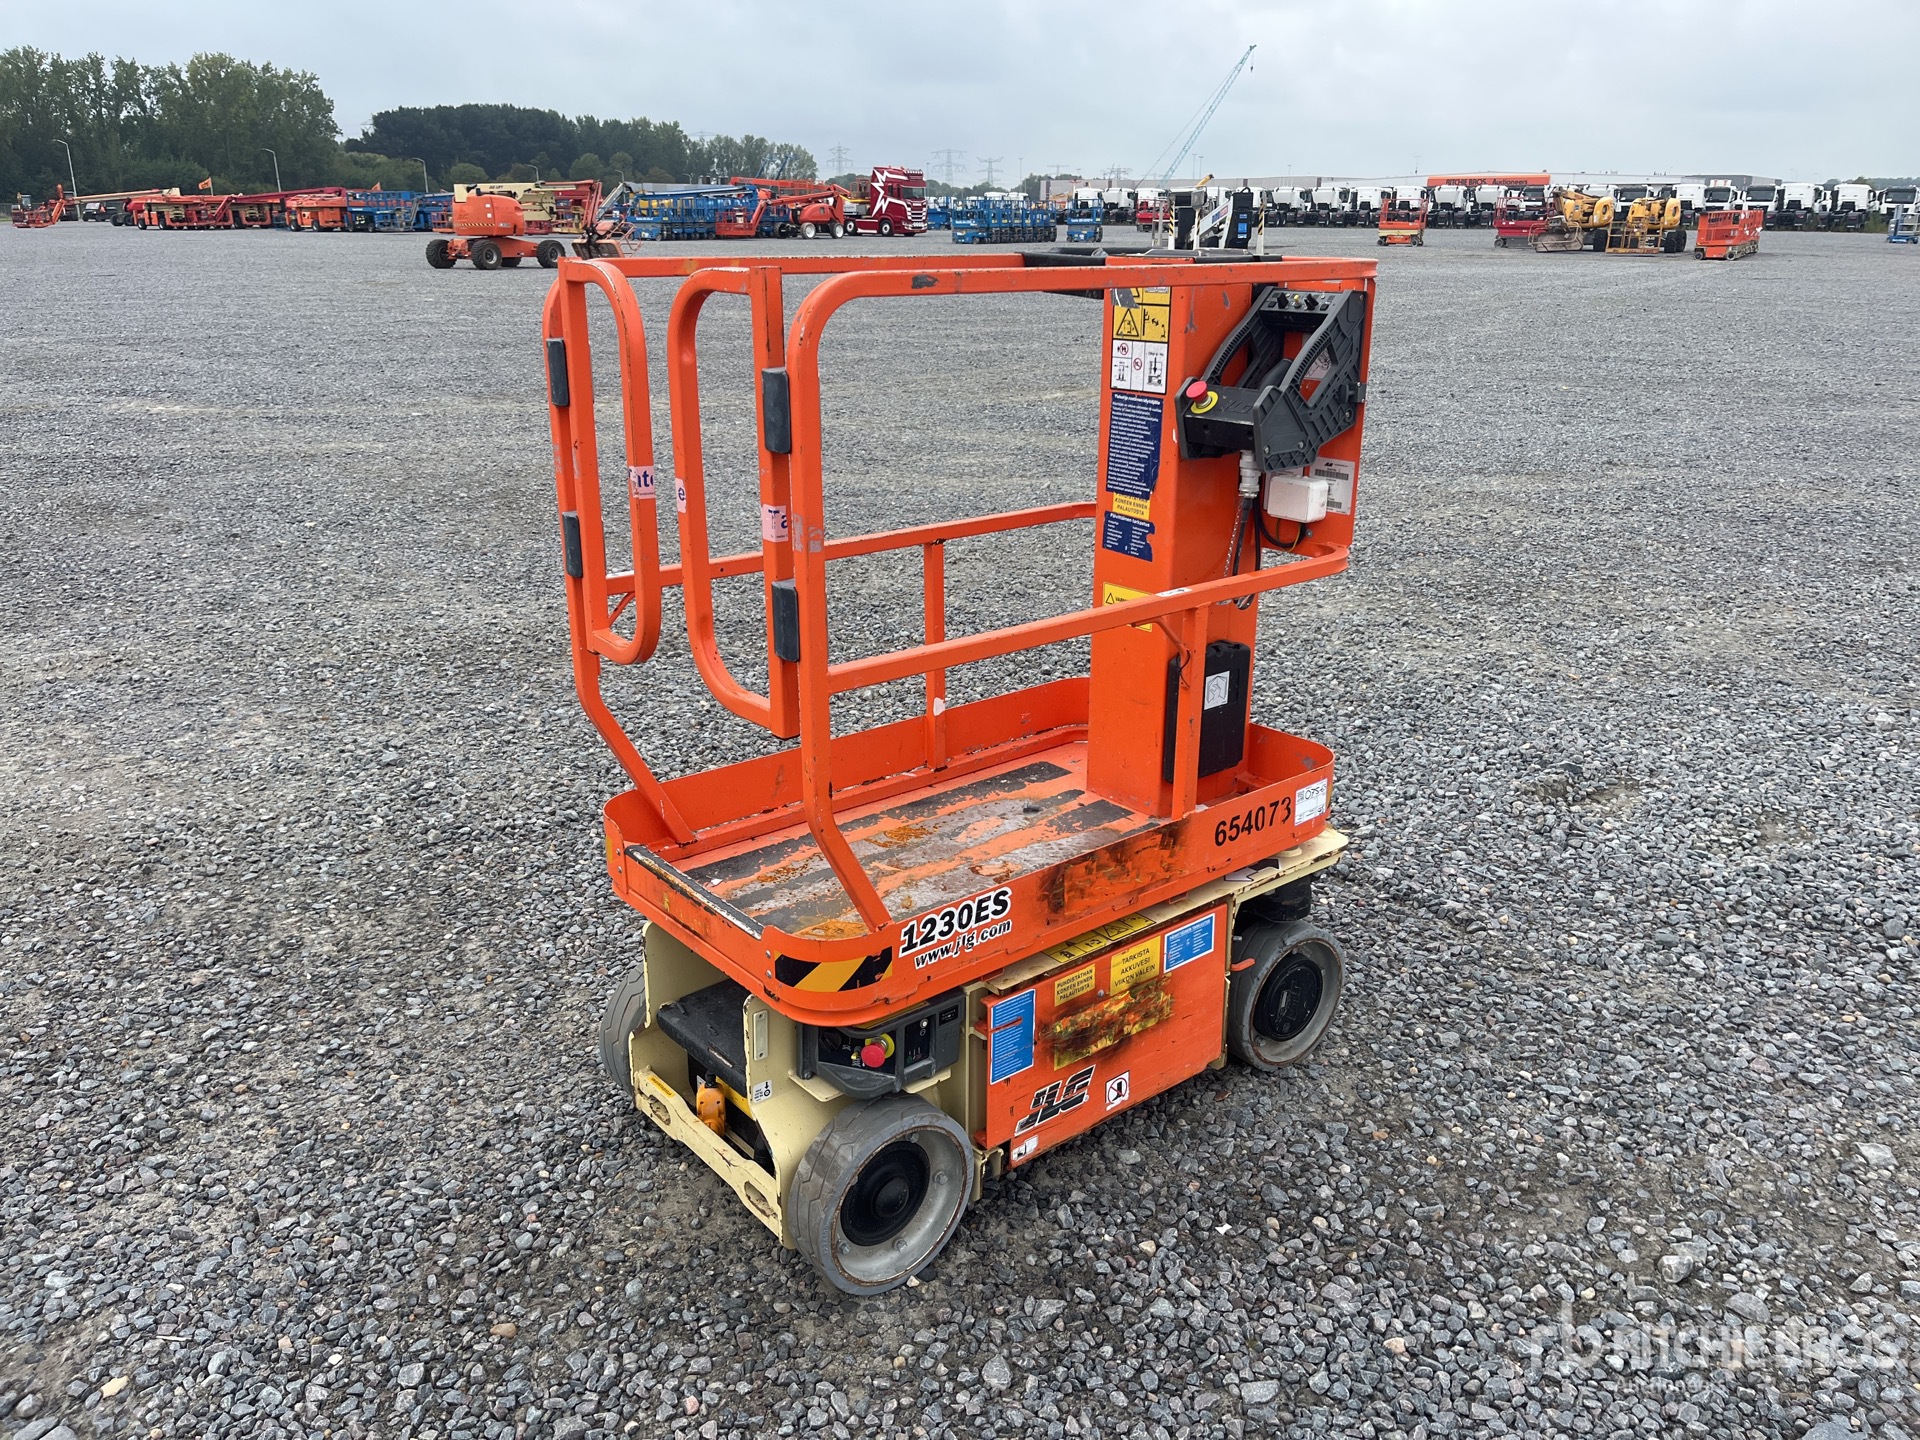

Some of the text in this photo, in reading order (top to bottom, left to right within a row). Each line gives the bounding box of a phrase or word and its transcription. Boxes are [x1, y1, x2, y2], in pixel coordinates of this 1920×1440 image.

[1214, 796, 1292, 847] 654073
[901, 889, 1010, 954] 1230ES
[914, 920, 1012, 968] www.jlg.com
[1120, 956, 1151, 975] AKKUVESI
[1122, 947, 1150, 965] TARKISTA
[1014, 1064, 1096, 1137] JLG
